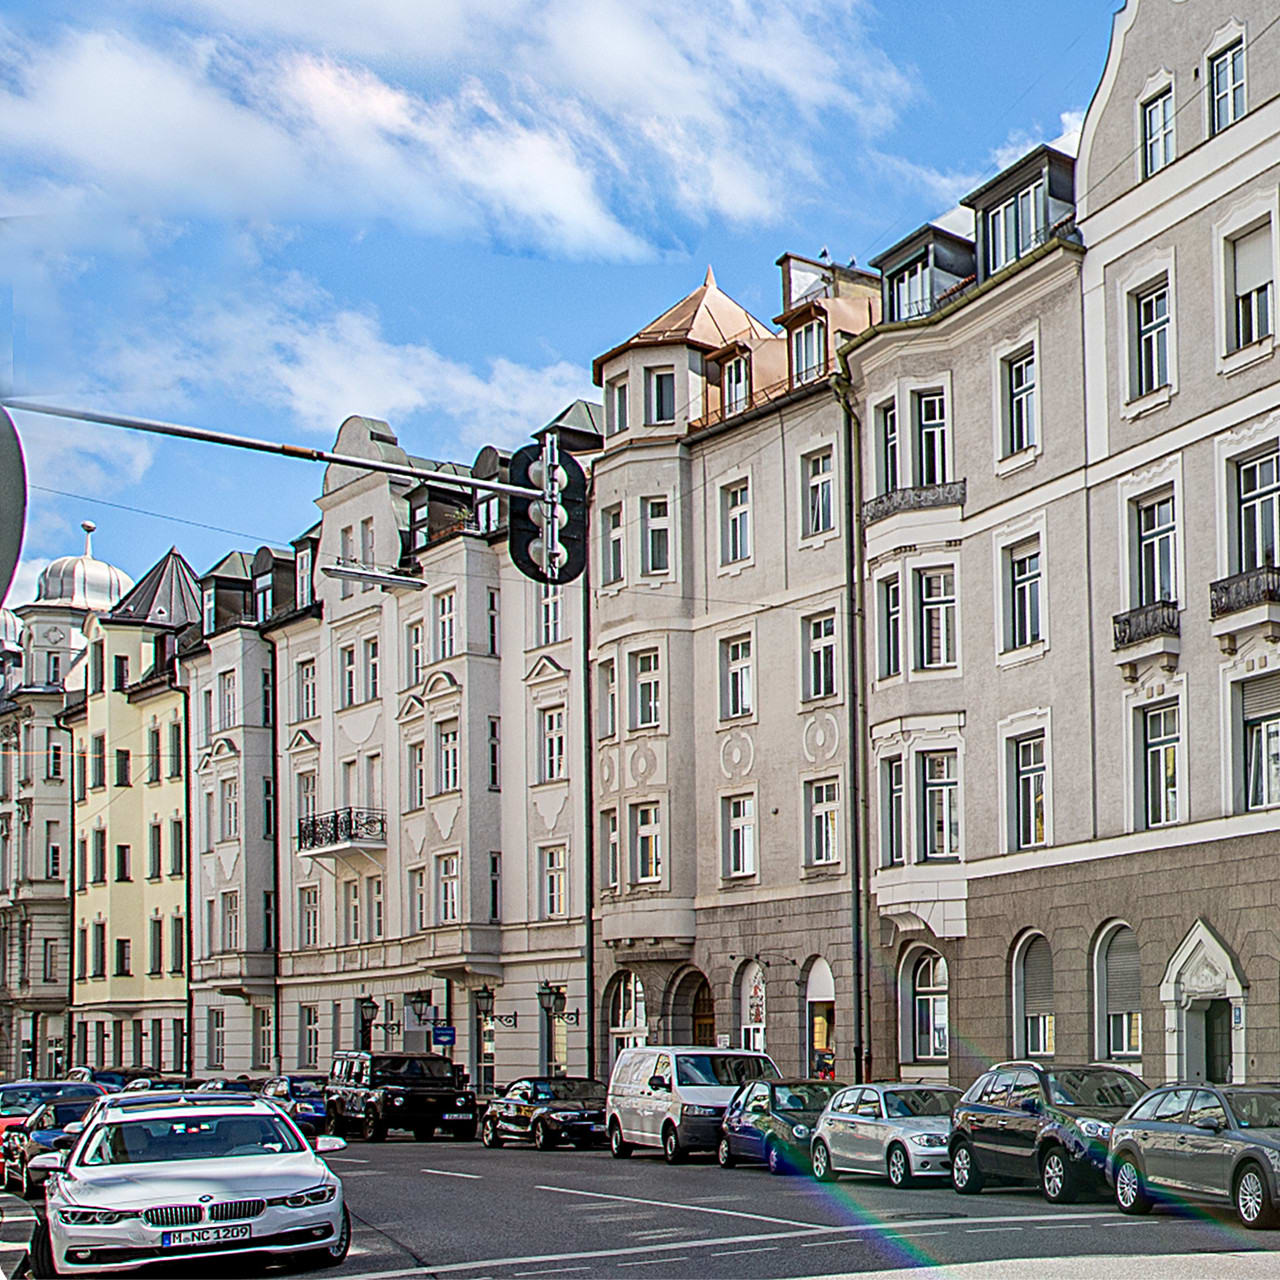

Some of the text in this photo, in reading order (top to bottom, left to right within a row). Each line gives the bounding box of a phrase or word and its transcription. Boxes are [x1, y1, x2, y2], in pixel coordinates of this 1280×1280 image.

[172, 1225, 249, 1244] M NC 1209
